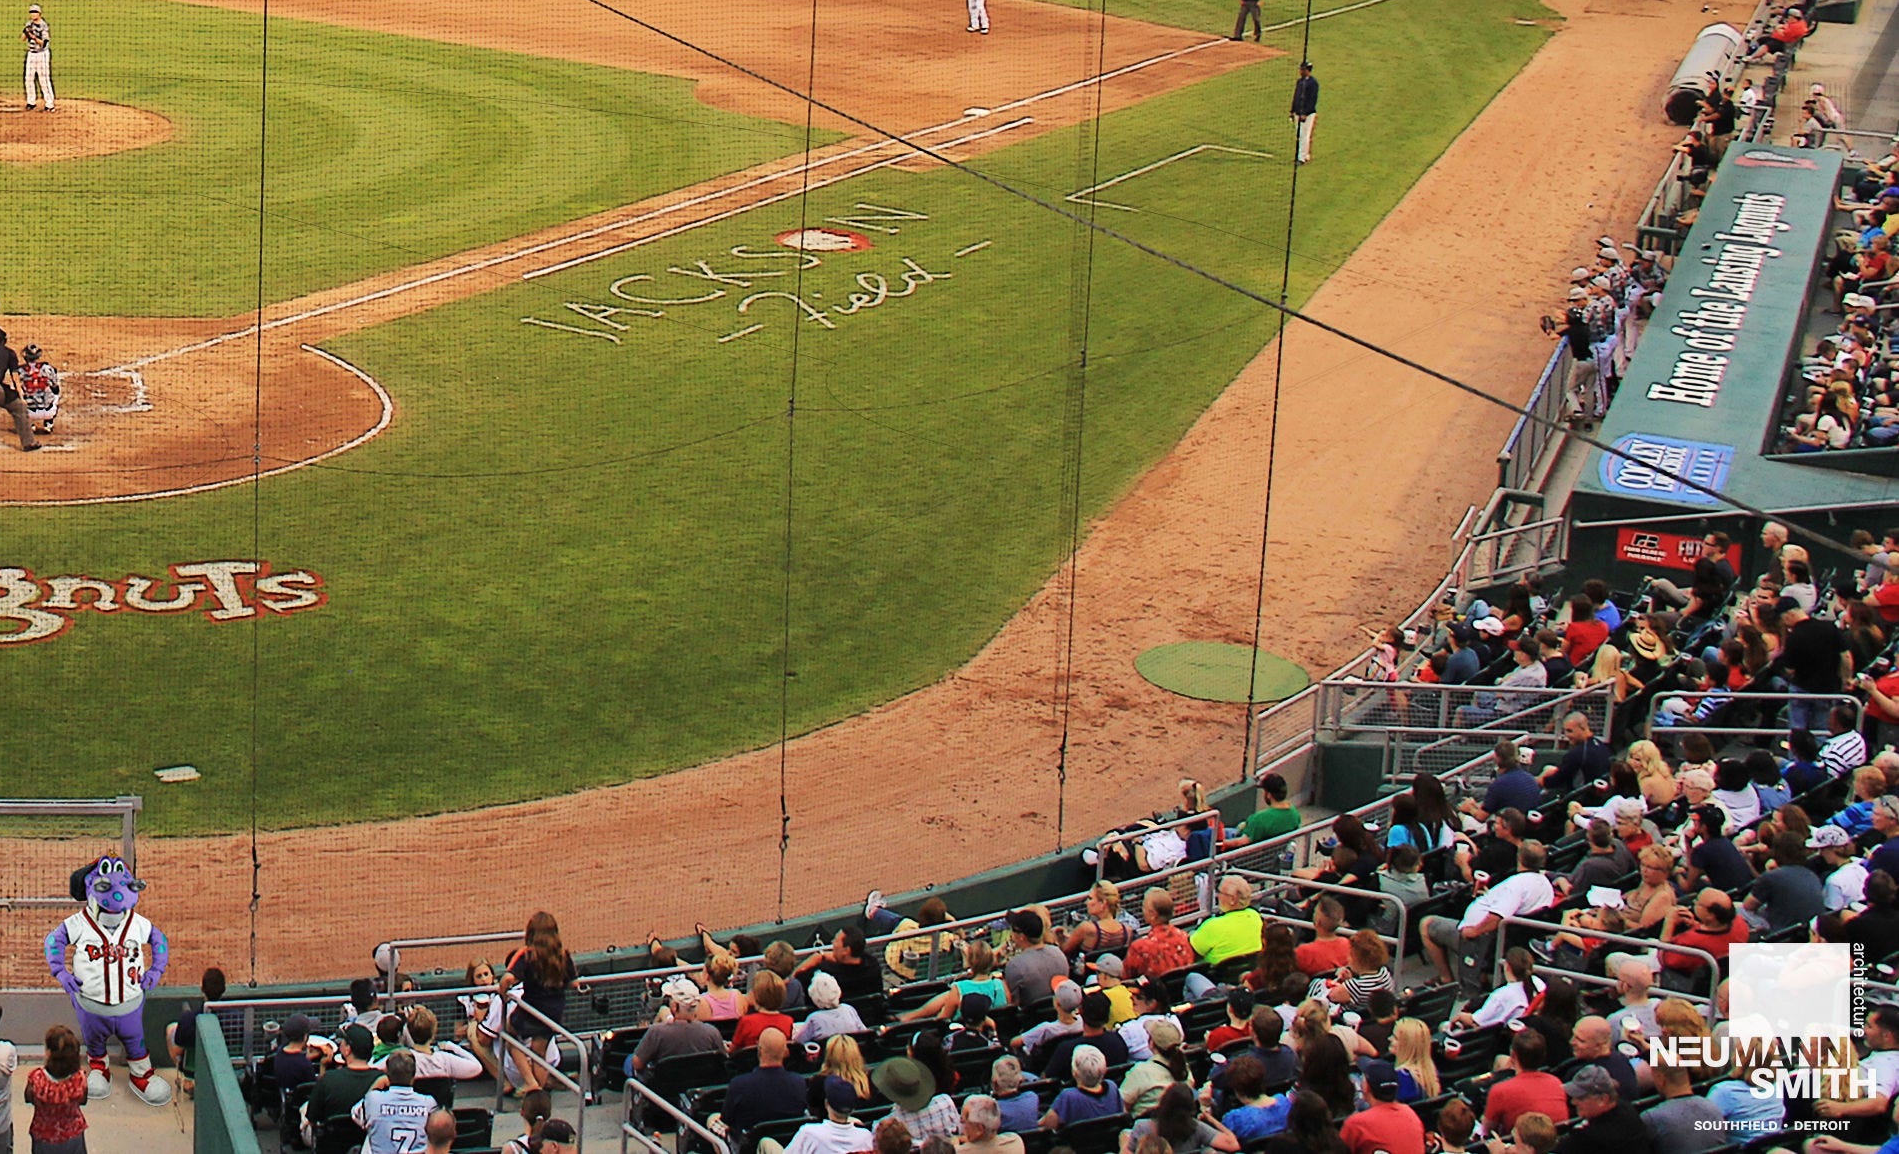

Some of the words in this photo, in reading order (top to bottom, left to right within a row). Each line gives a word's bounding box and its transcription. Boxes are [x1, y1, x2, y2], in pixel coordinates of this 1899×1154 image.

[1714, 191, 1792, 247] Lugnuts
[1690, 241, 1782, 304] Lansing
[1677, 300, 1746, 332] the
[1670, 326, 1736, 353] of
[1646, 350, 1729, 408] Home
[391, 1127, 417, 1154] 7
